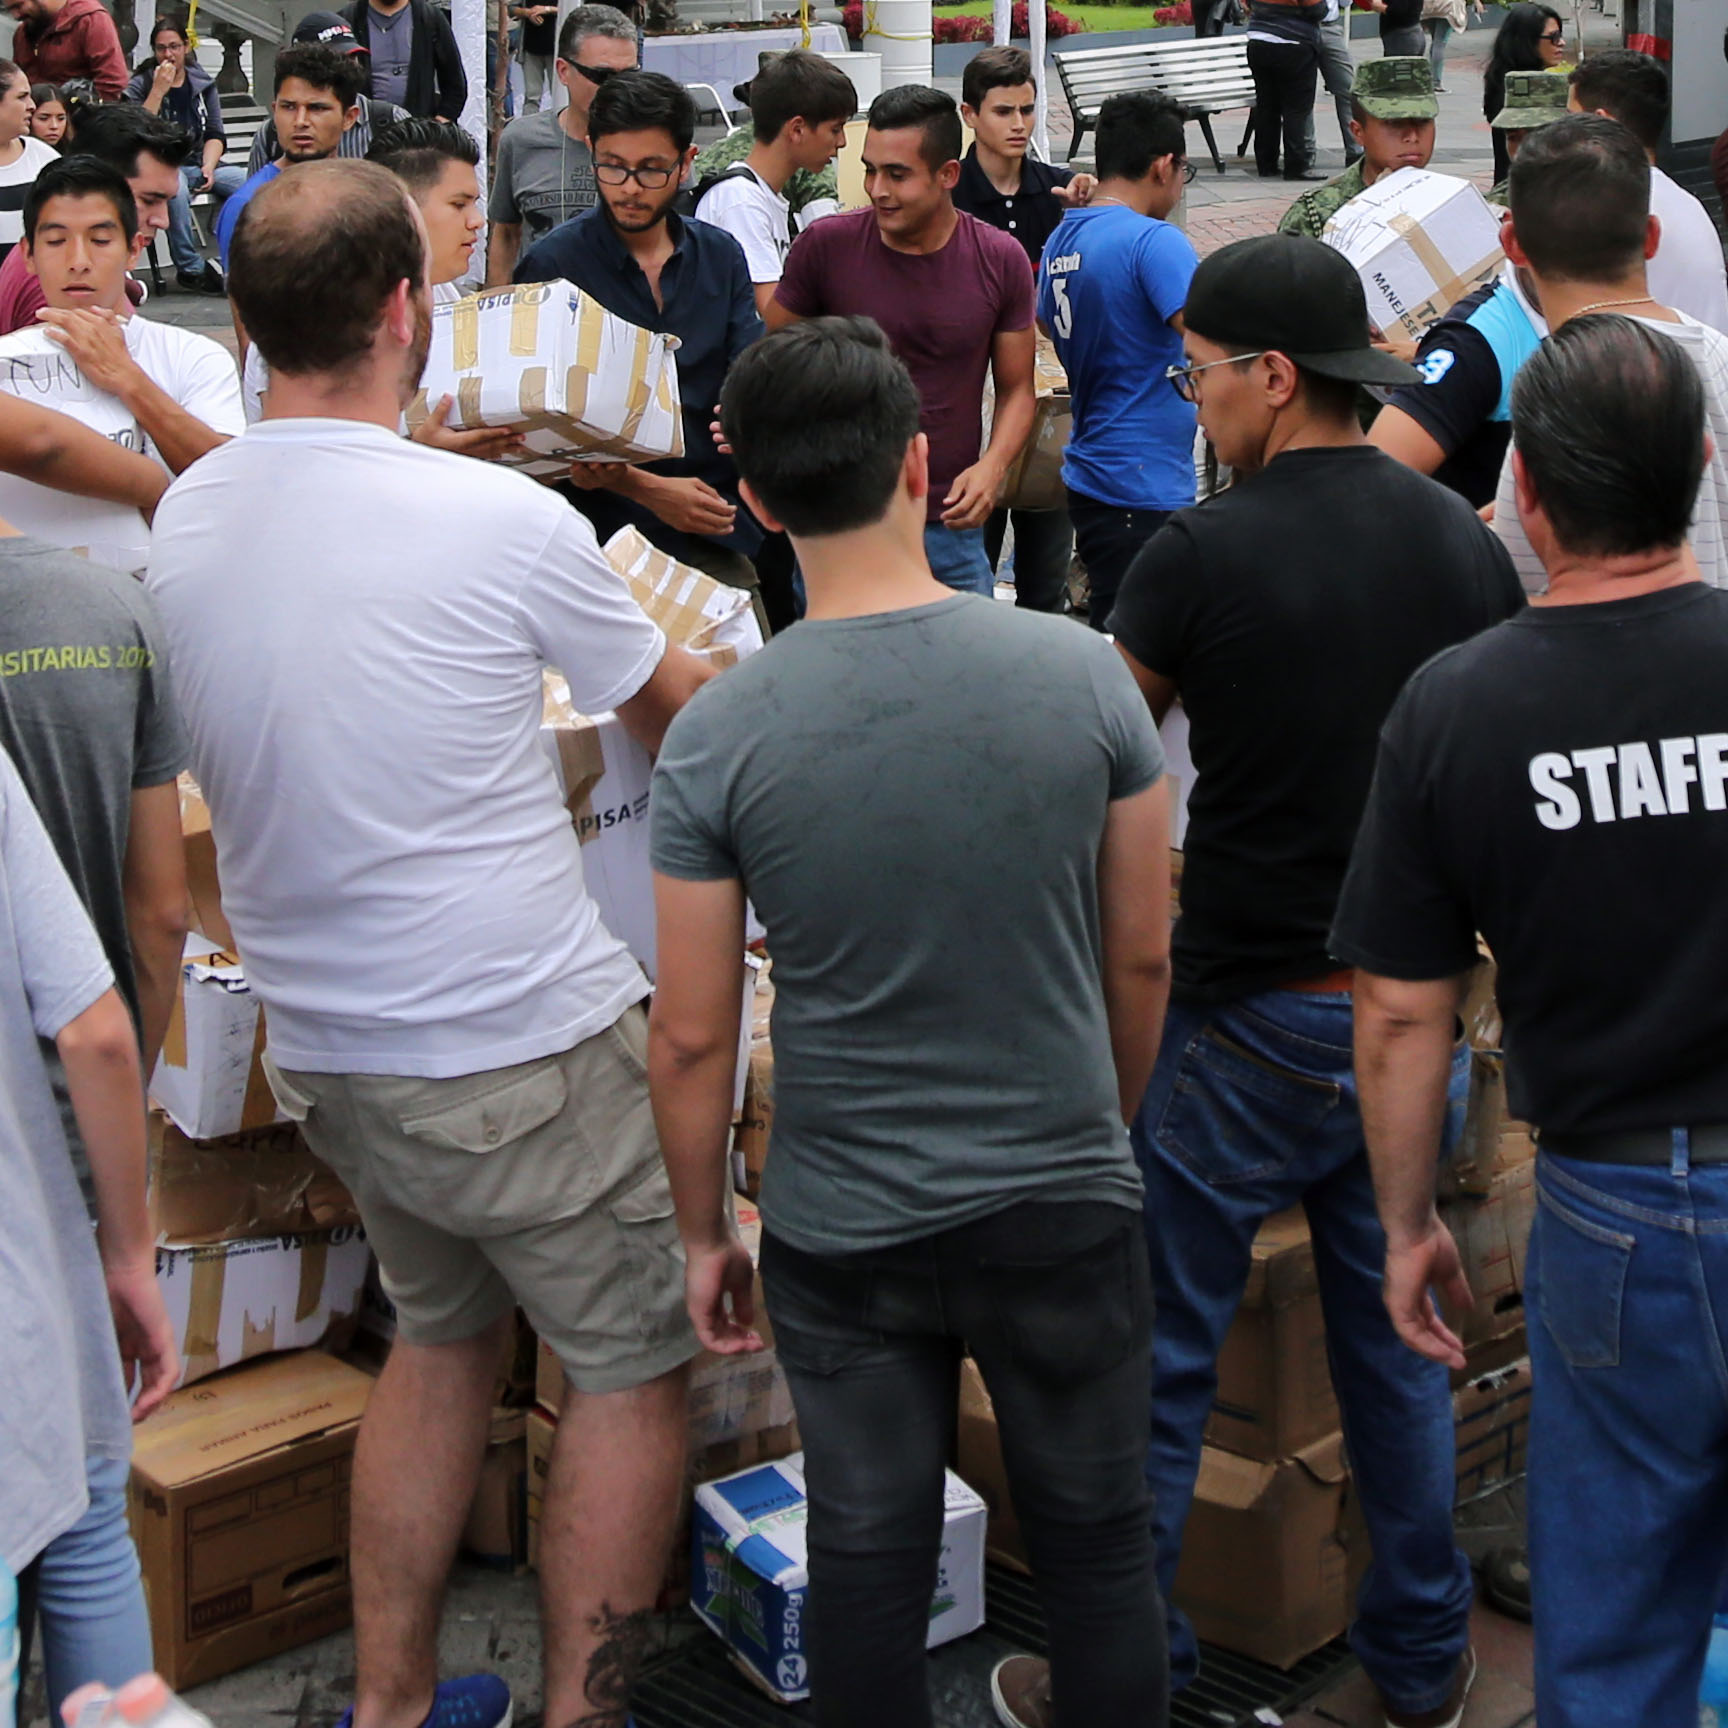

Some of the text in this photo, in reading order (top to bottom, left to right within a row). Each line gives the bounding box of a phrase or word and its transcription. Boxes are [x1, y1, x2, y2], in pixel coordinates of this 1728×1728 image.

[1052, 279, 1072, 339] 5
[1417, 348, 1455, 385] 3
[782, 1592, 804, 1688] 24 250g
